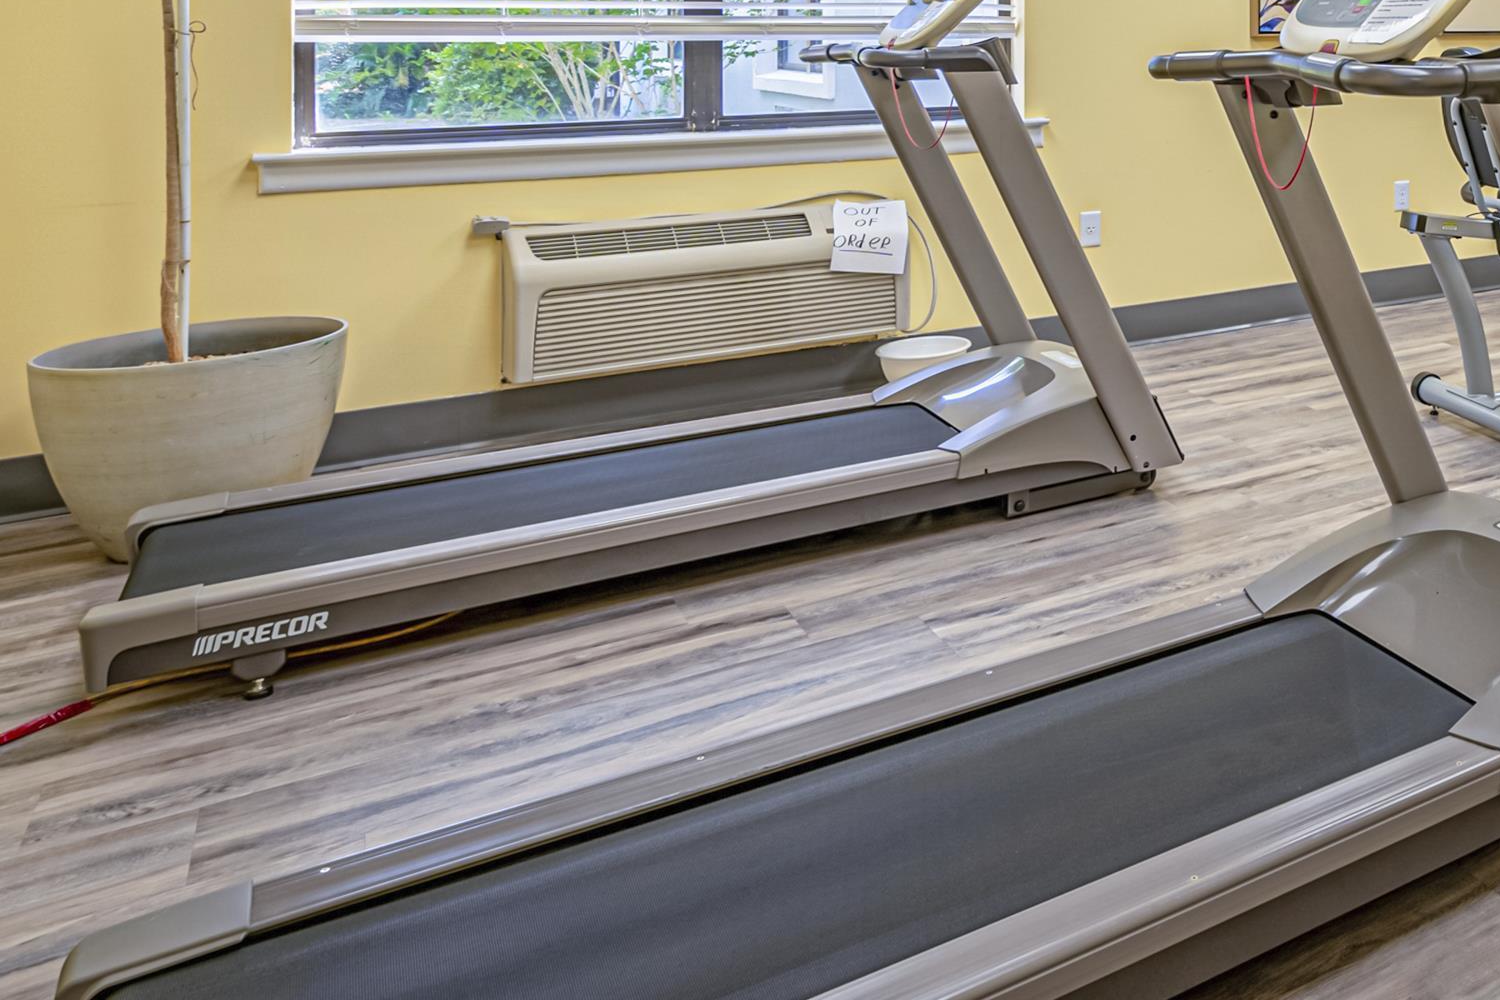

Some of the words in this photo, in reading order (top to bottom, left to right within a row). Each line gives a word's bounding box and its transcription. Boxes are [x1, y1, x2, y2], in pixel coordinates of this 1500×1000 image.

[843, 206, 886, 216] OUT
[854, 217, 880, 227] OF
[212, 611, 329, 653] PRECOR
